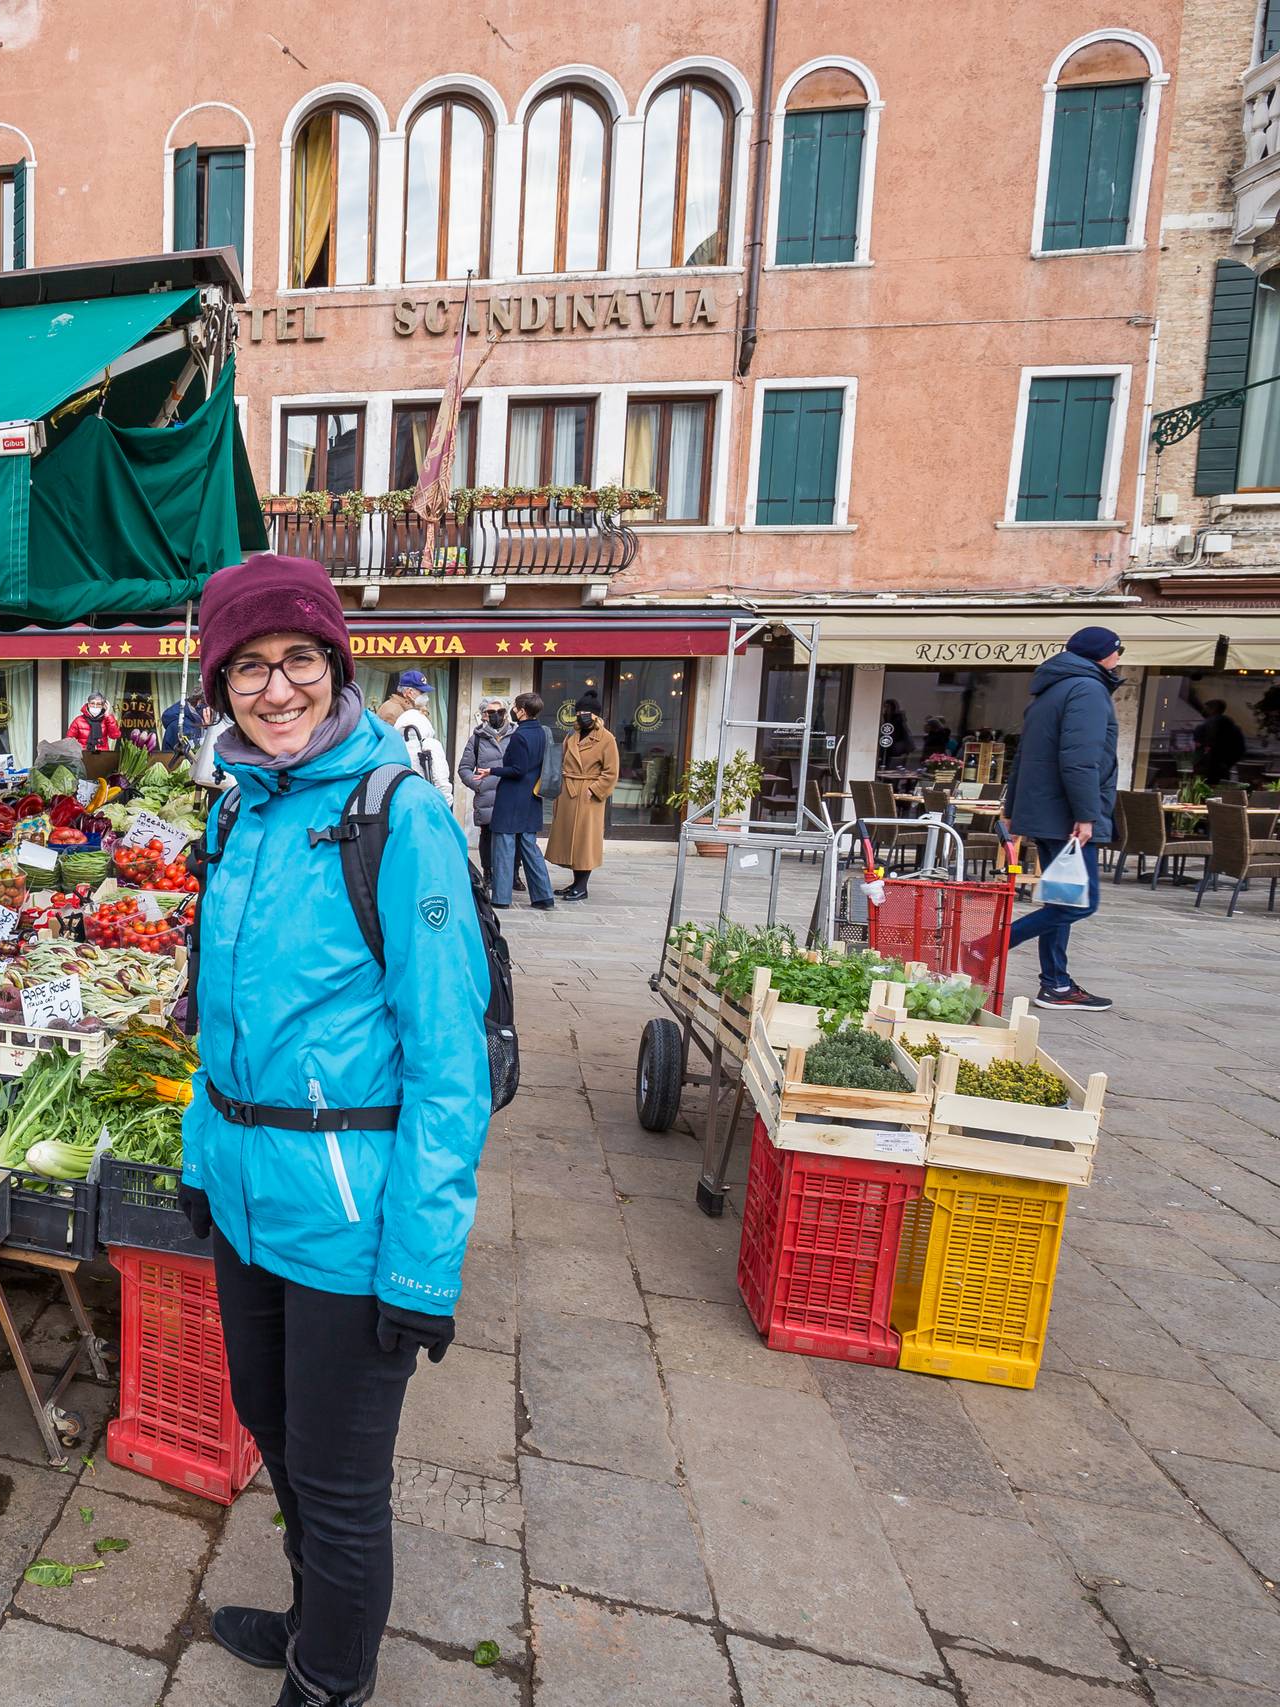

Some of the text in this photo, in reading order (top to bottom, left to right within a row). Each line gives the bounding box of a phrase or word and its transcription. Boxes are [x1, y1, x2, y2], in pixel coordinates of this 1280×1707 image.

[247, 288, 718, 342] TEL SCANDINAVIA
[3, 440, 25, 448] Gibus
[350, 635, 465, 655] DINAVIA
[915, 642, 1066, 663] RISTORANT
[21, 979, 71, 1001] RAPE ROSSE
